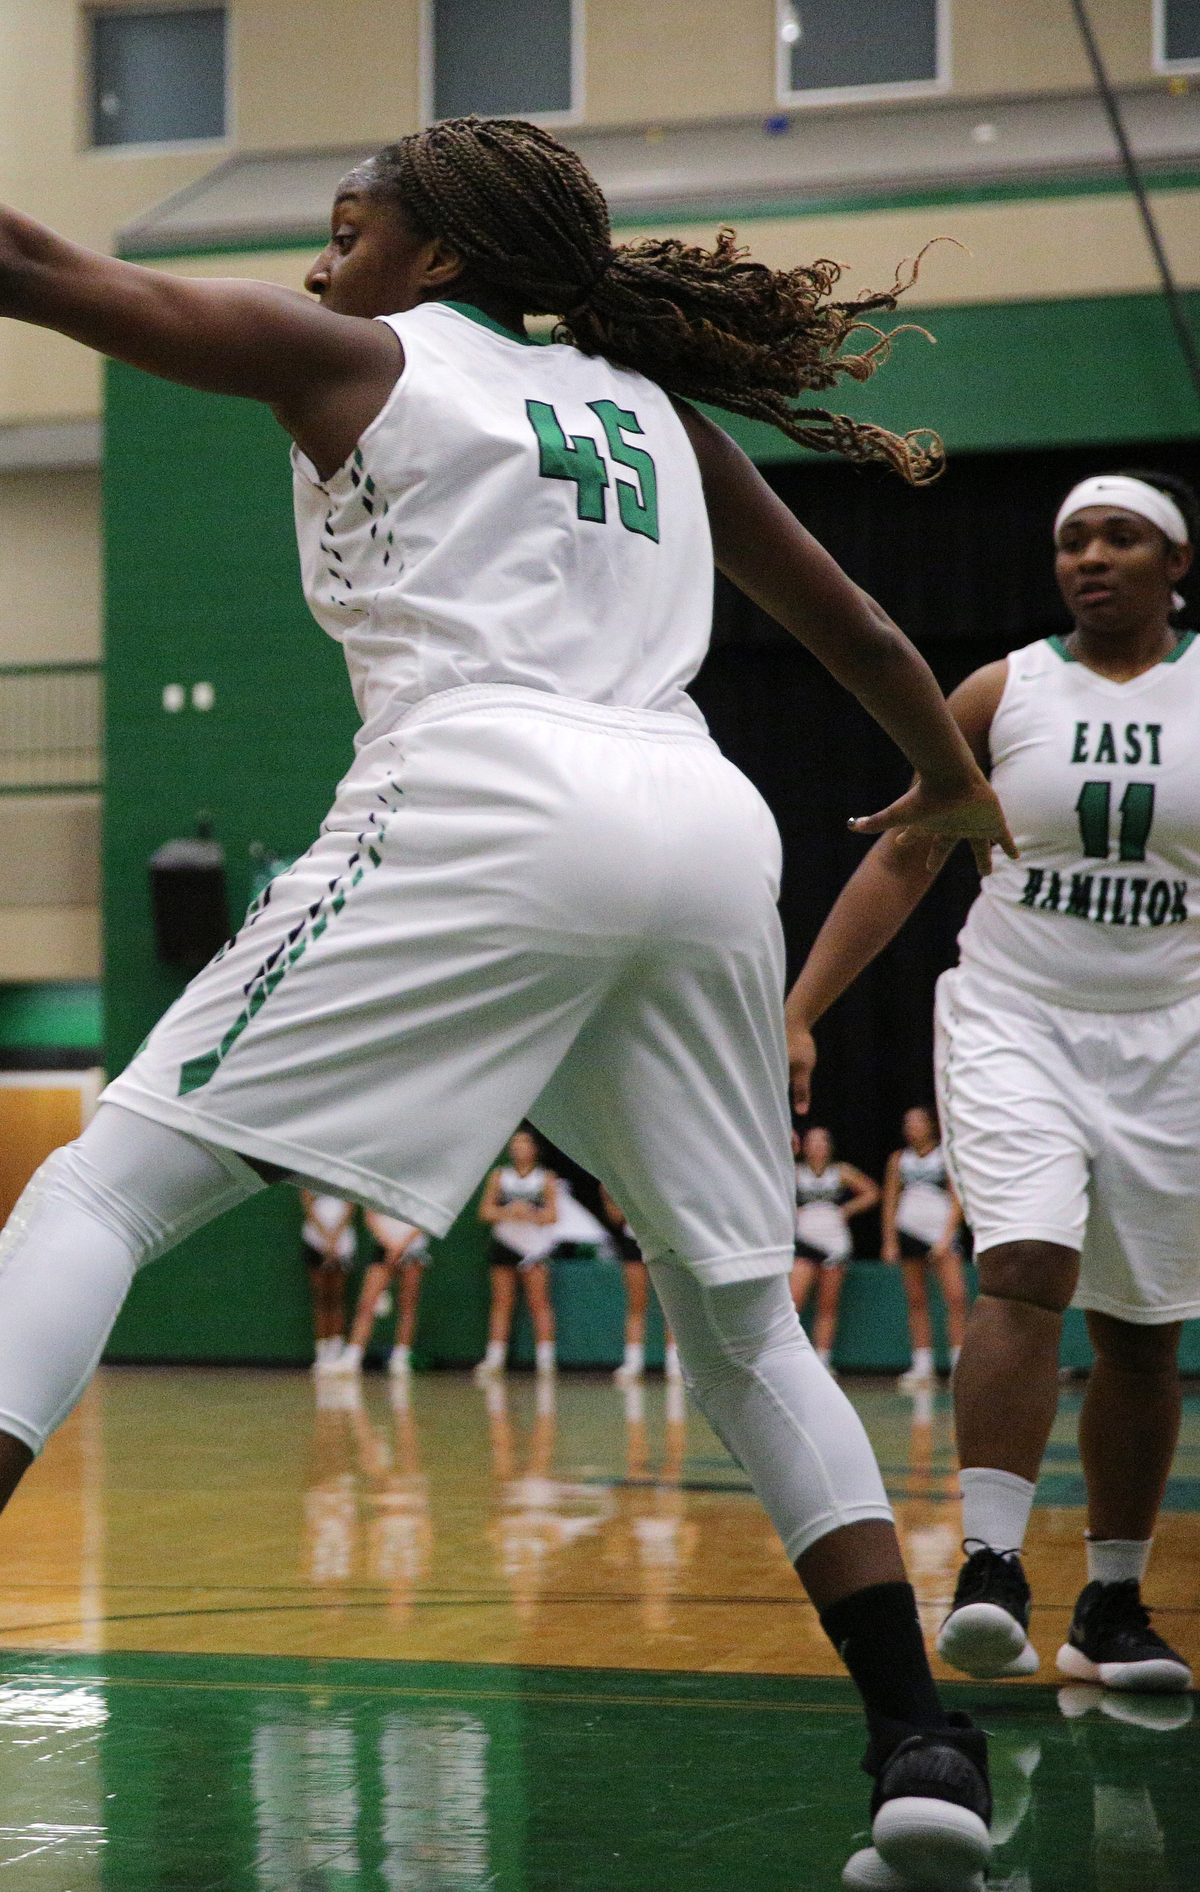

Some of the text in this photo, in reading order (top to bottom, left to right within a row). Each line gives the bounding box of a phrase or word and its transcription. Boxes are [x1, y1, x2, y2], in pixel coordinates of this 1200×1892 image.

[524, 399, 659, 544] 45
[1071, 721, 1162, 765] EAST
[1074, 781, 1155, 862] 11
[1019, 867, 1188, 927] HAMILTON
